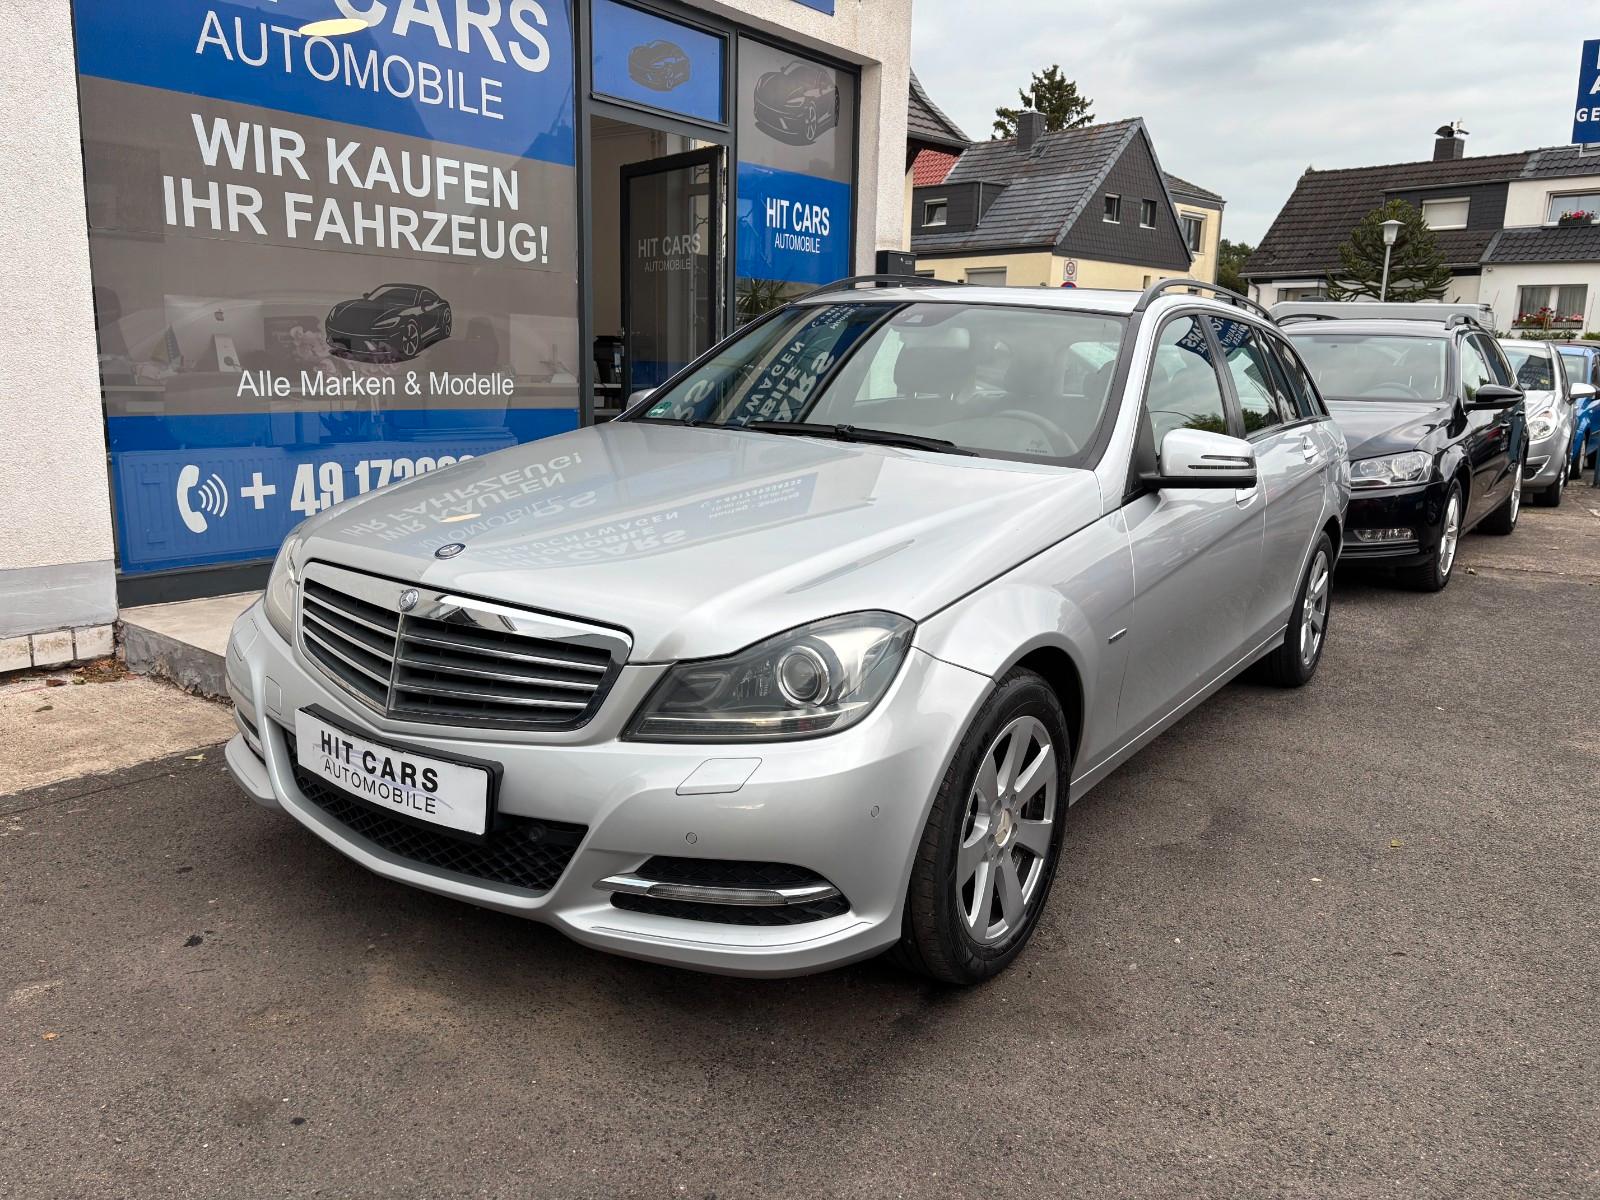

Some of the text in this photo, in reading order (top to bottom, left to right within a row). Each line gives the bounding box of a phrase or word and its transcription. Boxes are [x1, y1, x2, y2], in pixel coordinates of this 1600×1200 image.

[195, 10, 504, 119] AUTOMOBILE
[191, 113, 519, 210] WIR KAUFEN
[162, 175, 548, 264] IHR FAHRZEUG!
[766, 197, 830, 236] HIT CARS
[638, 233, 701, 258] HIT CARS
[644, 258, 691, 272] AUTOMOBILE
[774, 232, 821, 254] AUTOMOBILE
[236, 369, 515, 398] Alle Marken & Modelle
[321, 729, 439, 793] HIT CARS
[324, 758, 437, 815] AUTOMOBILE
